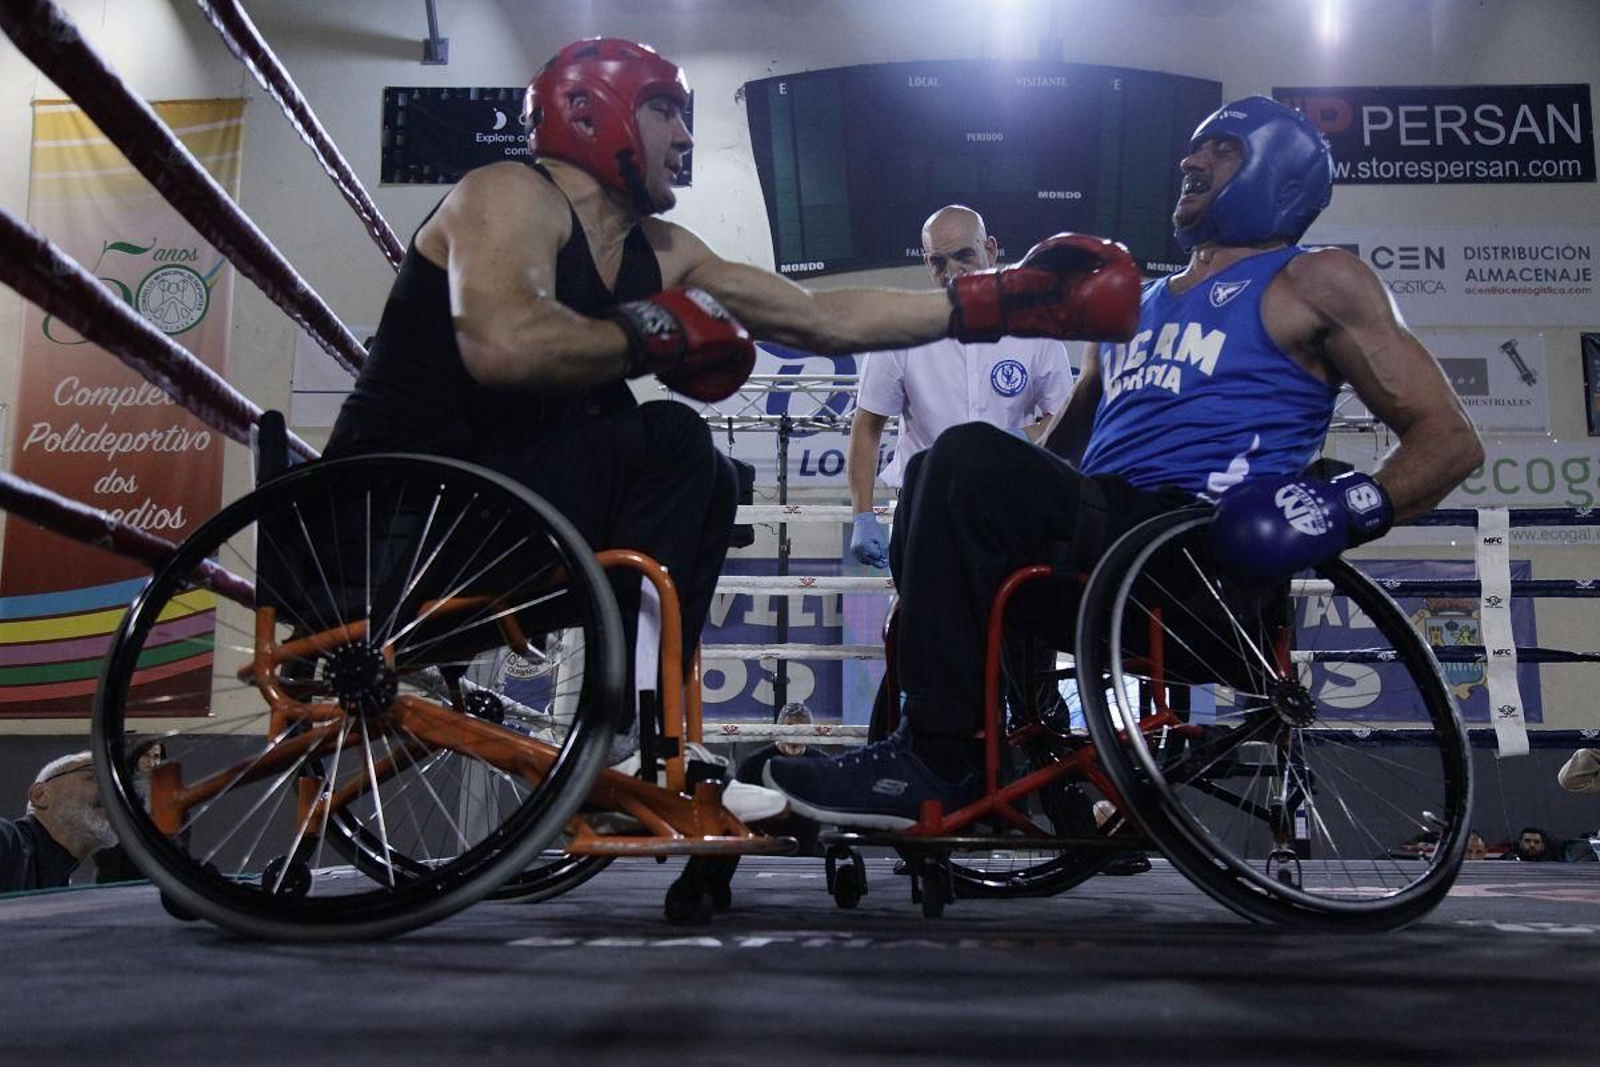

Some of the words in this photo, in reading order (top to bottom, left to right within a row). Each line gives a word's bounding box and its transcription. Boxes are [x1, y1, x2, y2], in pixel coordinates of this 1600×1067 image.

[908, 75, 940, 88] LOCAL
[1015, 76, 1067, 87] VISITANTE
[779, 82, 789, 96] E
[1361, 102, 1582, 147] PERSAN
[475, 132, 515, 144] Explore
[966, 131, 1004, 142] PERIODO
[1037, 190, 1082, 200] MONDO
[152, 246, 199, 262] anos
[1463, 242, 1591, 261] DISTRIBUCIÓN
[780, 261, 825, 273] MONDO
[1464, 267, 1592, 282] ALMACENAJE
[23, 422, 211, 461] Polideportivo
[94, 467, 138, 494] dos
[1483, 536, 1503, 545] MFC
[1493, 648, 1511, 656] MFC
